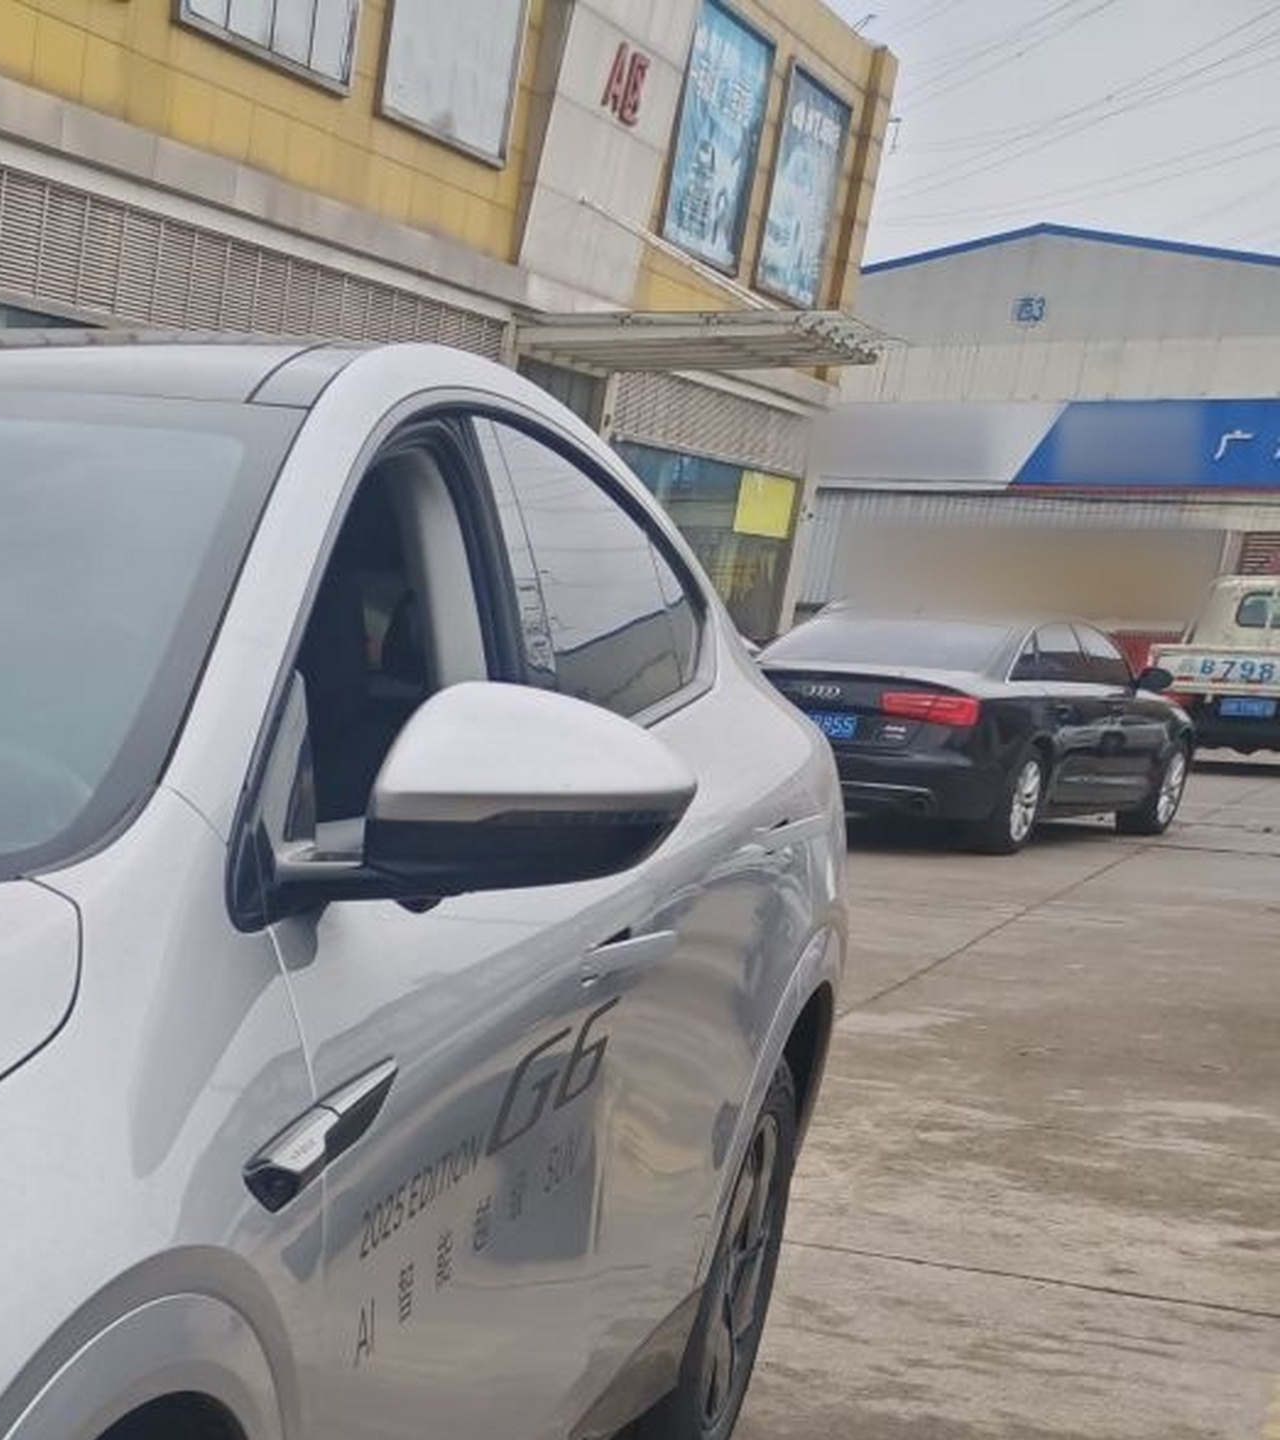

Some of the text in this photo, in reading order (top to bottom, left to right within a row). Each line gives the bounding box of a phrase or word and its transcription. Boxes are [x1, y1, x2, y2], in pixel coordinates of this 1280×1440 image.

[359, 996, 621, 1260] 2025 EDITION G6
[354, 1298, 377, 1367] AI
